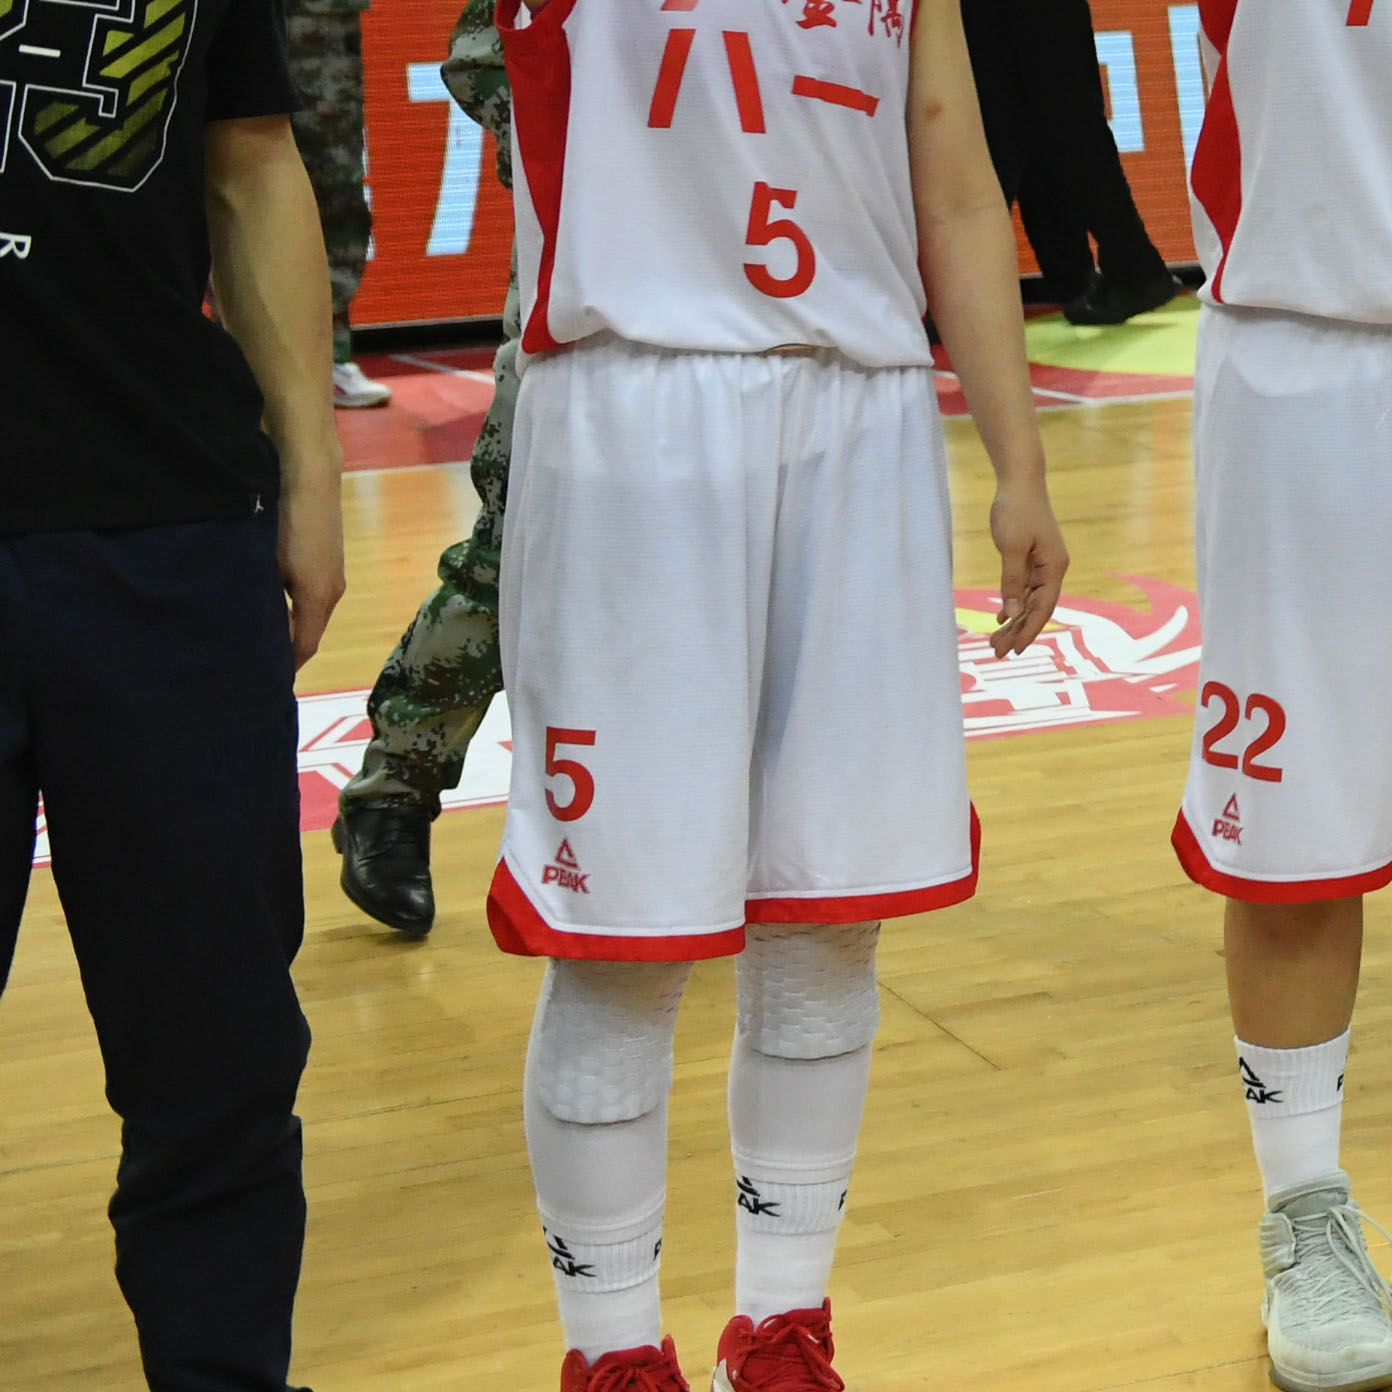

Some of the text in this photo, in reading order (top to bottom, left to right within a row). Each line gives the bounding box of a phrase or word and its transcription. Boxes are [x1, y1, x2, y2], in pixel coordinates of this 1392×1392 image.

[647, 29, 879, 134] 八一
[743, 181, 817, 299] 5
[544, 726, 598, 823] 5
[1200, 680, 1287, 783] 22
[542, 864, 590, 895] PEAK
[1211, 818, 1243, 846] PEAK
